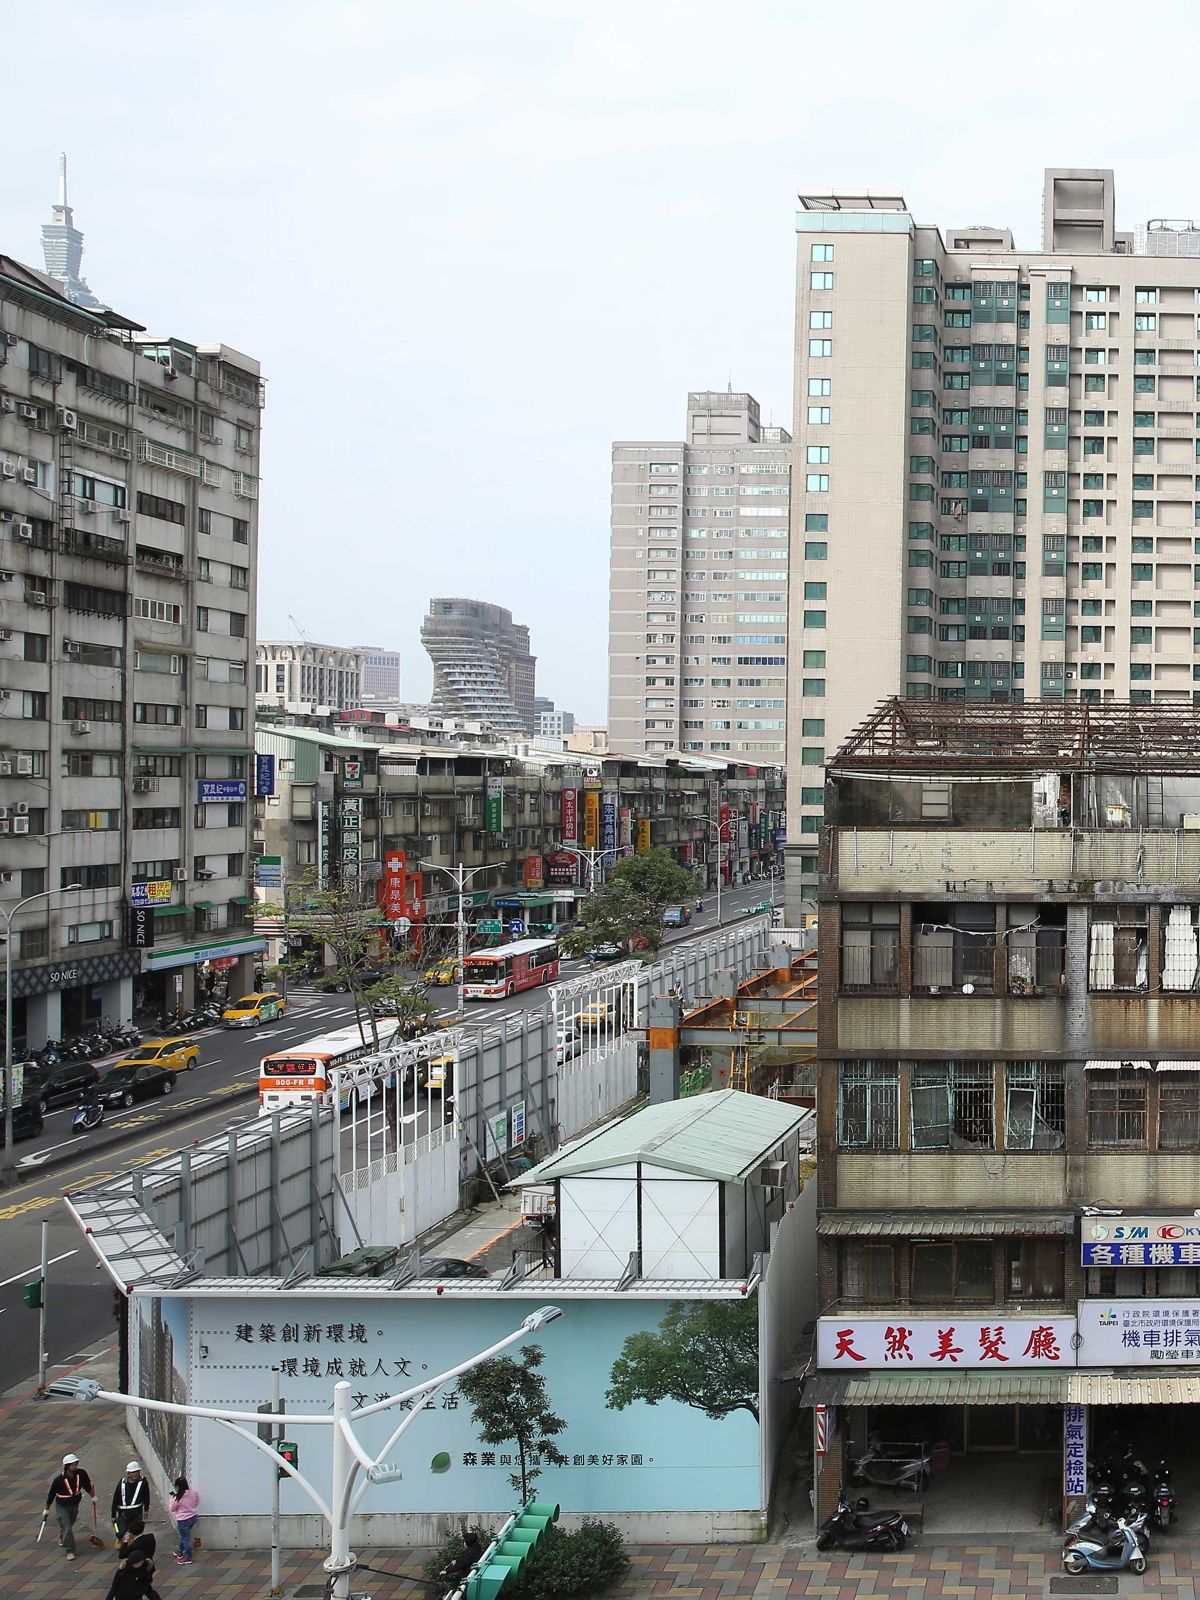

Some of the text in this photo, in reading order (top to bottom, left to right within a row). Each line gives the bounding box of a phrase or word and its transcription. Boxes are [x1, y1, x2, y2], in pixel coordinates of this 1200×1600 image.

[390, 877, 401, 913] 康是美
[136, 910, 146, 945] SO NICE
[50, 969, 77, 982] SO NICE
[1113, 1226, 1149, 1240] SYM
[1122, 1309, 1200, 1318] 行政院環境保護署
[833, 1324, 1062, 1363] 天然美髮廳
[1066, 1406, 1085, 1494] 排氣定檢站
